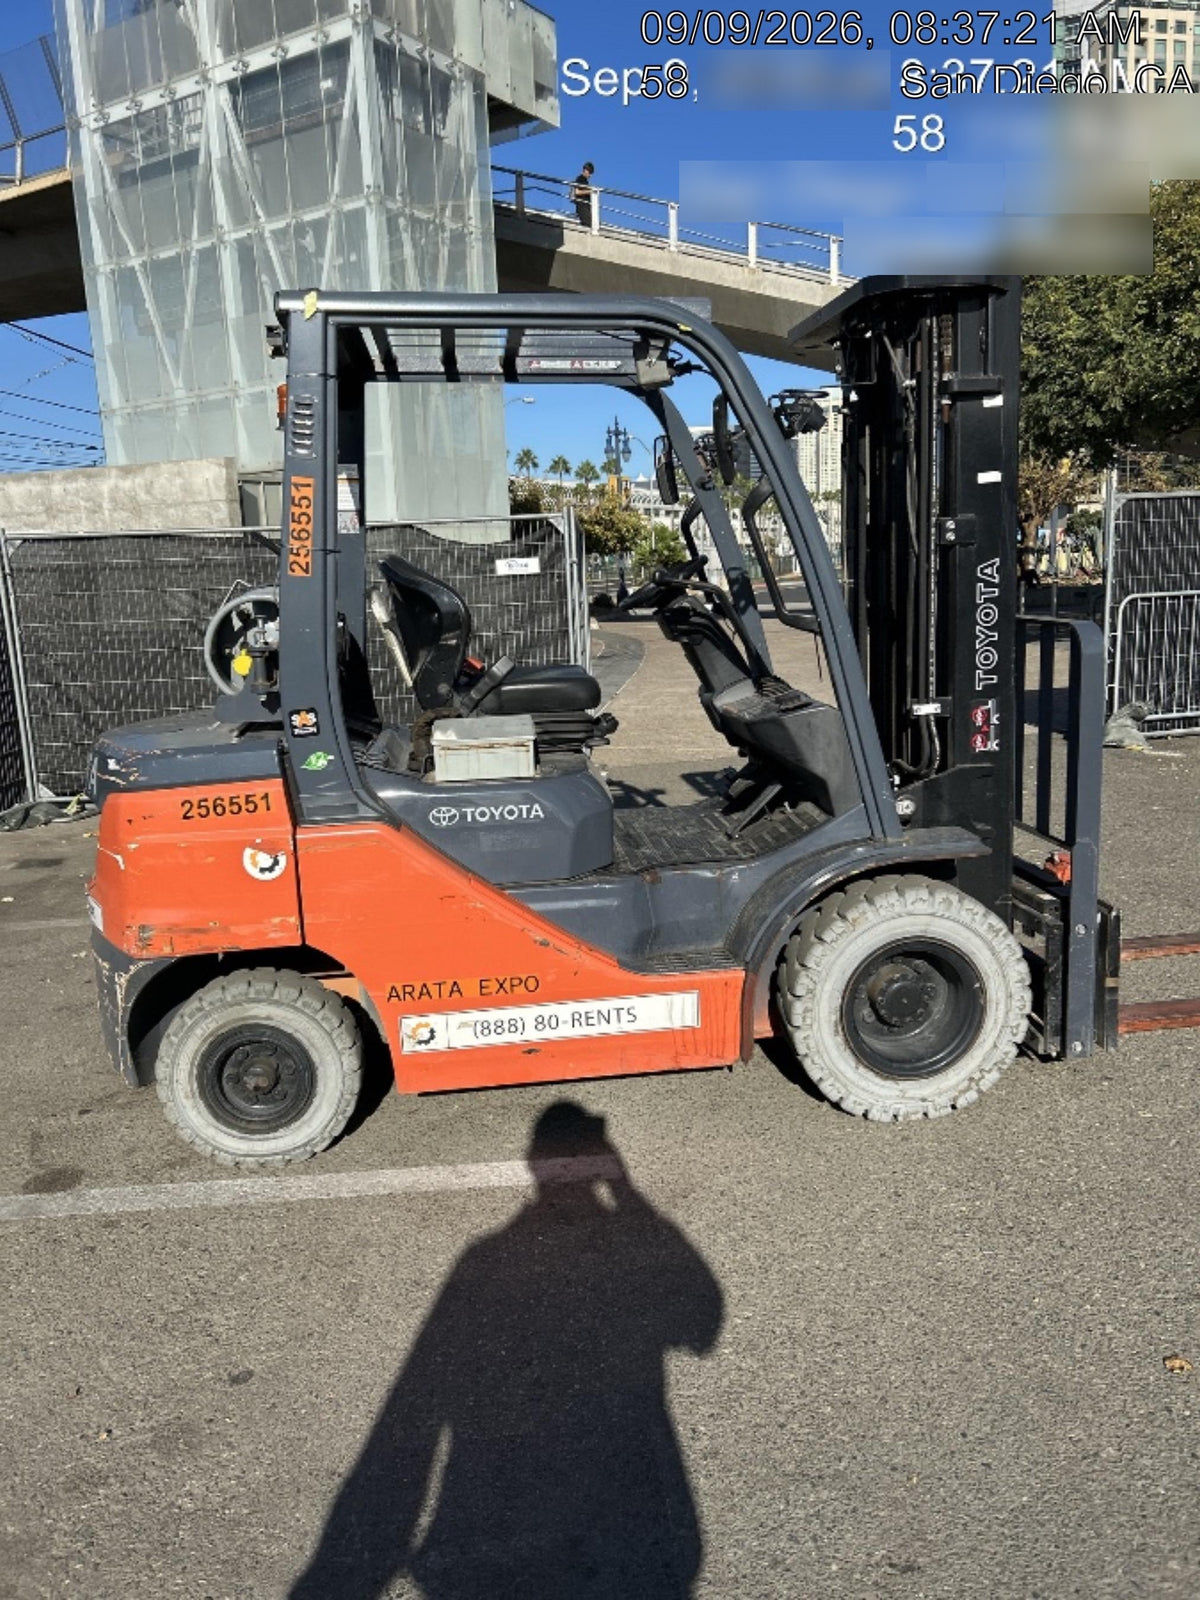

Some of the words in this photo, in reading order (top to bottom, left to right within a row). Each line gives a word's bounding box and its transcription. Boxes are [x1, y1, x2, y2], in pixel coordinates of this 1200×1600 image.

[288, 482, 313, 575] 256551
[975, 557, 1001, 691] TOYOTA
[180, 792, 271, 820] 256551
[461, 802, 545, 822] TOYOTA
[386, 979, 464, 1002] ARATA
[478, 974, 541, 997] EXPO
[473, 1015, 526, 1039] (888)
[533, 1006, 638, 1031] 80-RENTS
